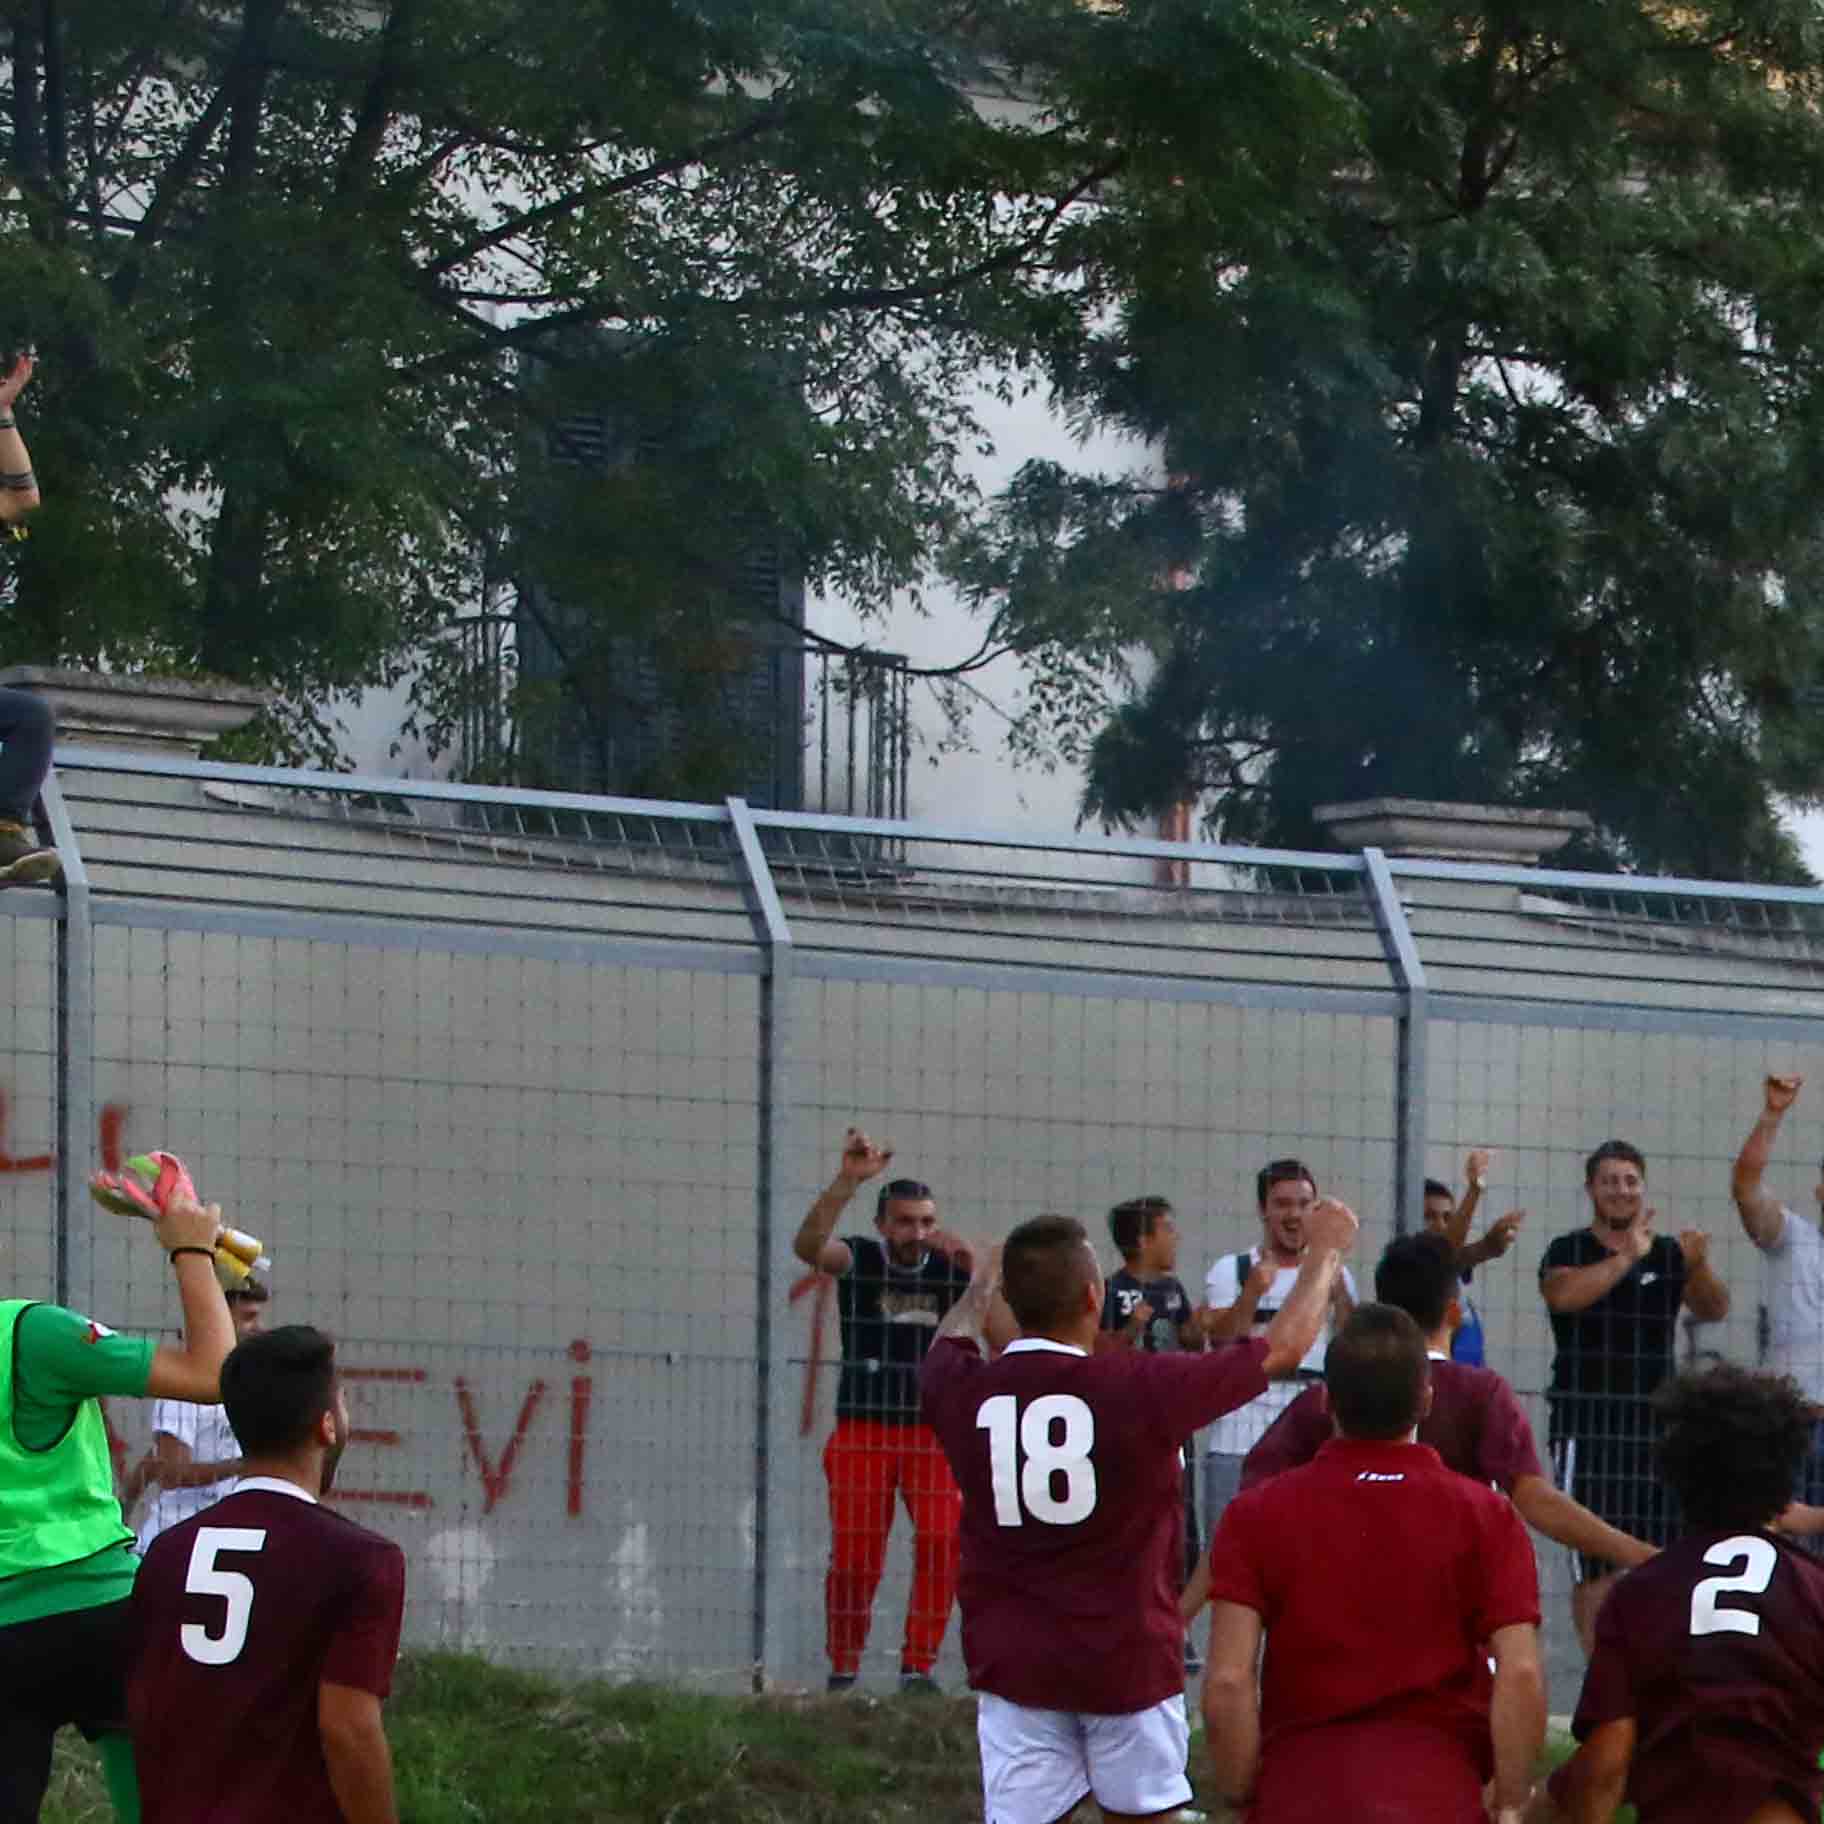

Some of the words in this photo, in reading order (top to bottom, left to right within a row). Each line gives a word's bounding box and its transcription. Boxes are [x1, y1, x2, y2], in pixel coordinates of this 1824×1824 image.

[976, 1394, 1097, 1527] 18
[181, 1526, 267, 1665] 5
[1690, 1535, 1777, 1636] 2
